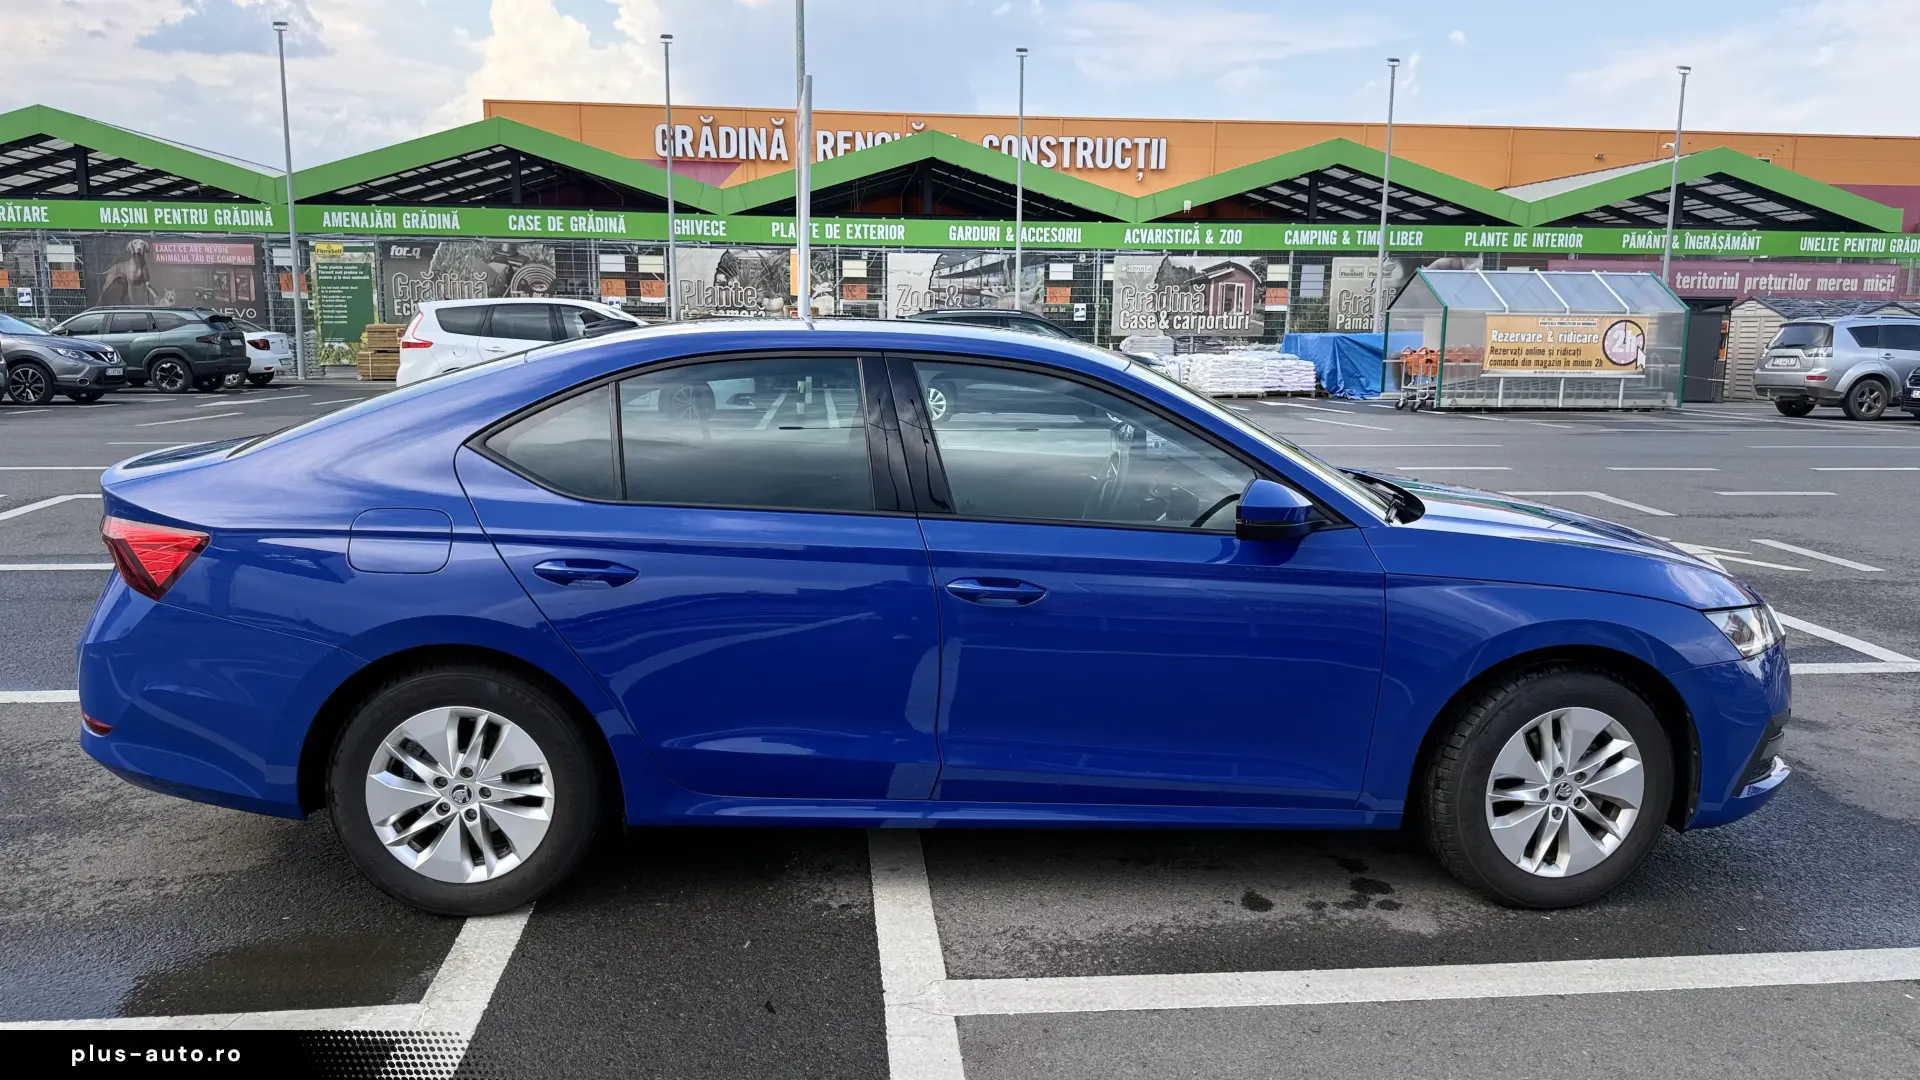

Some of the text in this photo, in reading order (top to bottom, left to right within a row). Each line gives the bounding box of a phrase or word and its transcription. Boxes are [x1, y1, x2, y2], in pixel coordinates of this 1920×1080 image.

[654, 115, 789, 161] GRĂDINĂ
[100, 206, 273, 228] MAȘINI PENTRU GRĂDINĂ
[323, 210, 460, 230] AMENAJĂRI GRĂDINĂ
[508, 214, 626, 234] CASE DE GRĂDINĂ
[674, 219, 727, 236] GHIVECE
[771, 222, 905, 240] PLAE DE EXTERIOR
[949, 225, 1082, 243] GARDURI & ACCESORII
[1124, 223, 1242, 245] ACVARISTICĂ & ZOO
[1284, 230, 1337, 246] CAMPING
[1342, 230, 1350, 245] &
[1389, 231, 1423, 246] LIBER
[1465, 232, 1583, 248] PLANTE DE INTERIOR
[1622, 230, 1762, 253] PĂMÂNT & ÎNGRĂȘĂMÂNT
[1800, 236, 1840, 252] UNELTE
[1843, 237, 1886, 253] PENTRU
[392, 272, 488, 301] Grădină
[680, 280, 757, 307] Plante
[1675, 271, 1739, 290] teritoriul
[1744, 272, 1812, 296] prețurilor
[1817, 276, 1858, 291] mereu
[1863, 275, 1896, 293] mici!
[896, 284, 936, 311] Zoo
[945, 284, 963, 309] &
[1120, 283, 1206, 313] Grădină
[1119, 310, 1250, 334] Case & carporturi
[1491, 330, 1600, 344] Rezervare & ridicare
[1489, 346, 1523, 358] Rezervați
[1525, 346, 1546, 356] online
[1556, 347, 1582, 358] ridicați
[1489, 358, 1519, 367] comanda
[1520, 358, 1532, 367] din
[1533, 358, 1562, 369] magazin
[1572, 358, 1593, 367] minim
